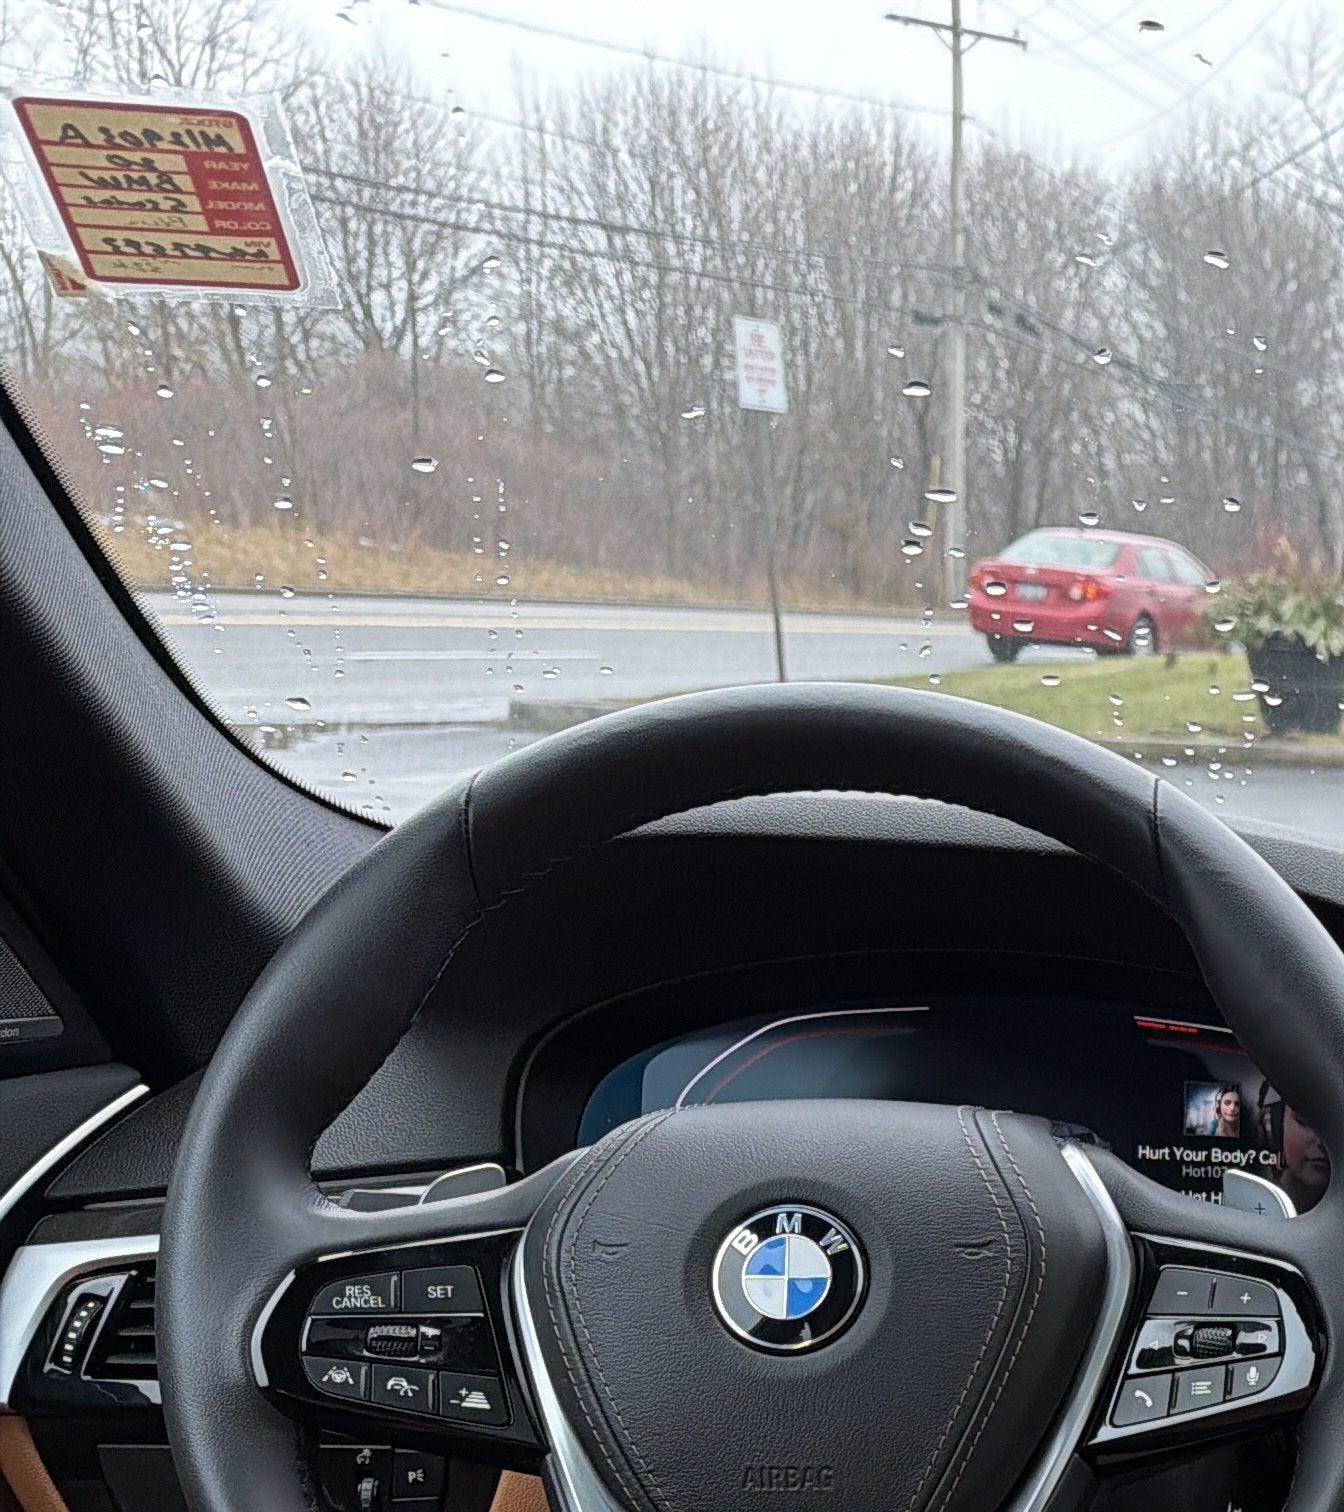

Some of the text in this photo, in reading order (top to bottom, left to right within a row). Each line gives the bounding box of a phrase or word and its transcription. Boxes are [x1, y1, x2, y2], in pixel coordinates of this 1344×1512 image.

[1138, 1145, 1170, 1160] Hurt
[1172, 1146, 1208, 1162] Your
[1211, 1148, 1256, 1166] Body?
[732, 1213, 848, 1256] BMW
[346, 1285, 371, 1298] RES
[427, 1286, 454, 1298] SET
[333, 1297, 386, 1309] CANCEL
[742, 1465, 833, 1491] AIRBAG
